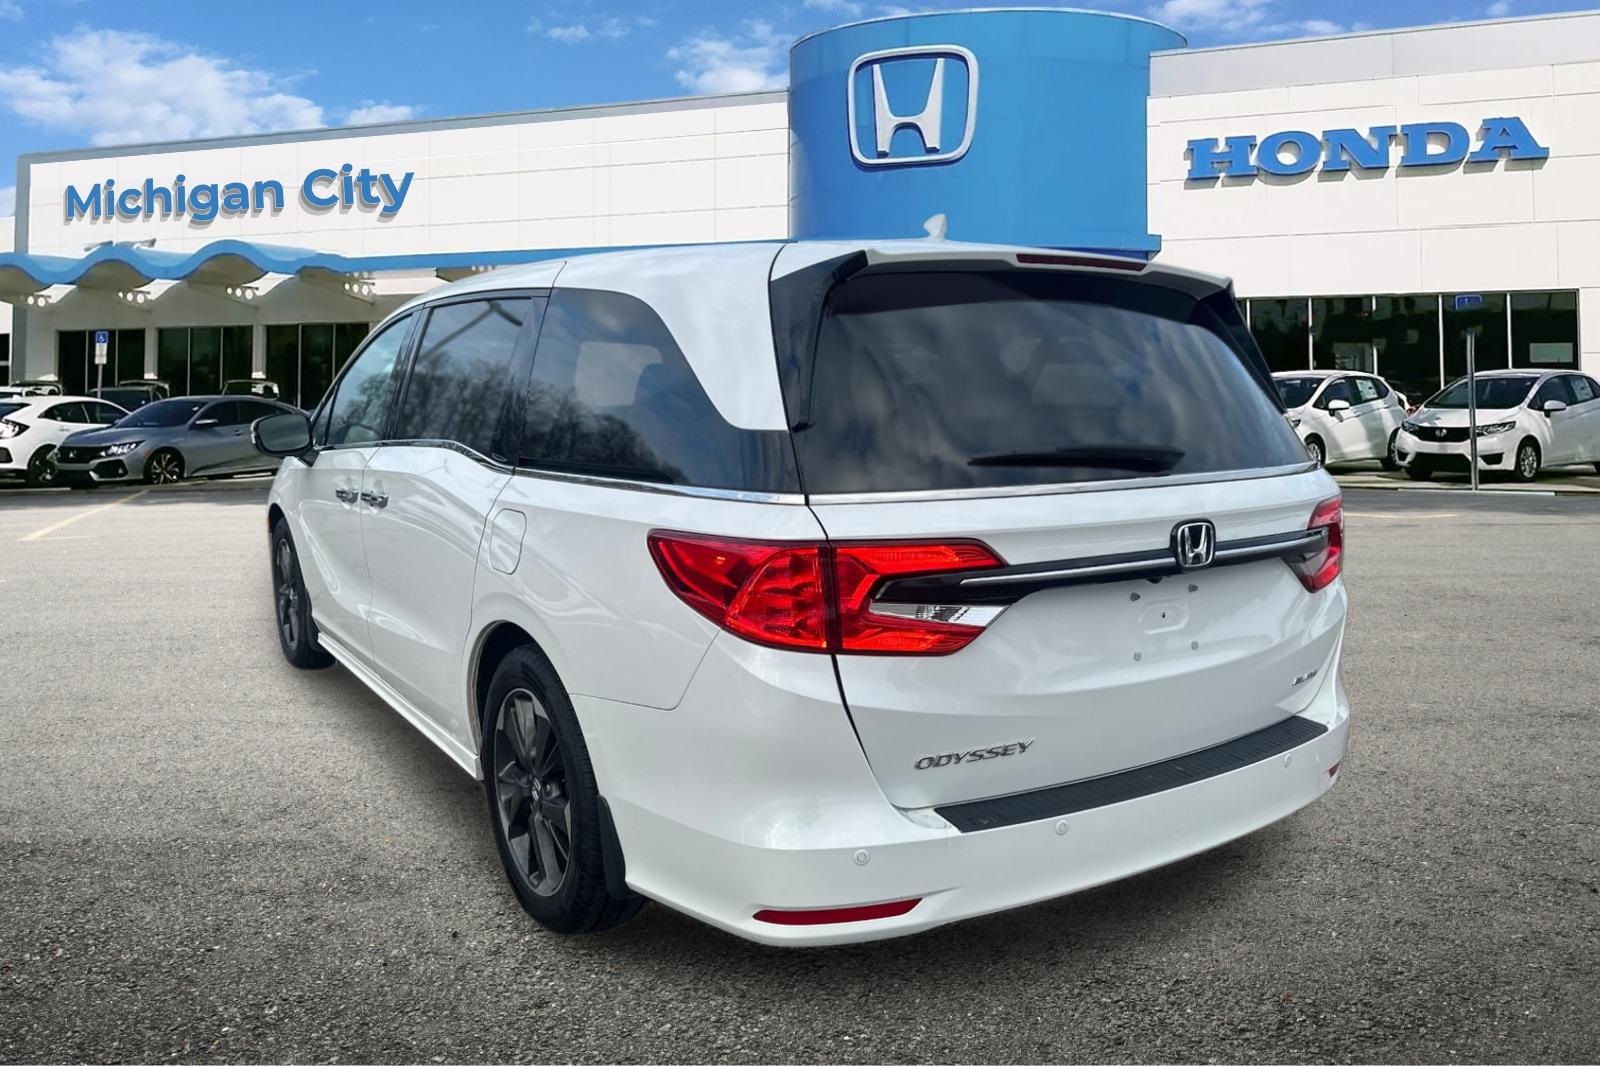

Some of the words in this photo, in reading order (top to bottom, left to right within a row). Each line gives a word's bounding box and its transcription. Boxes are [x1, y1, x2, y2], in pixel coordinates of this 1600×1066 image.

[1186, 116, 1550, 184] HONDA
[65, 173, 284, 223] Michigan
[302, 162, 415, 216] City
[914, 738, 1036, 770] ODYSSEY
